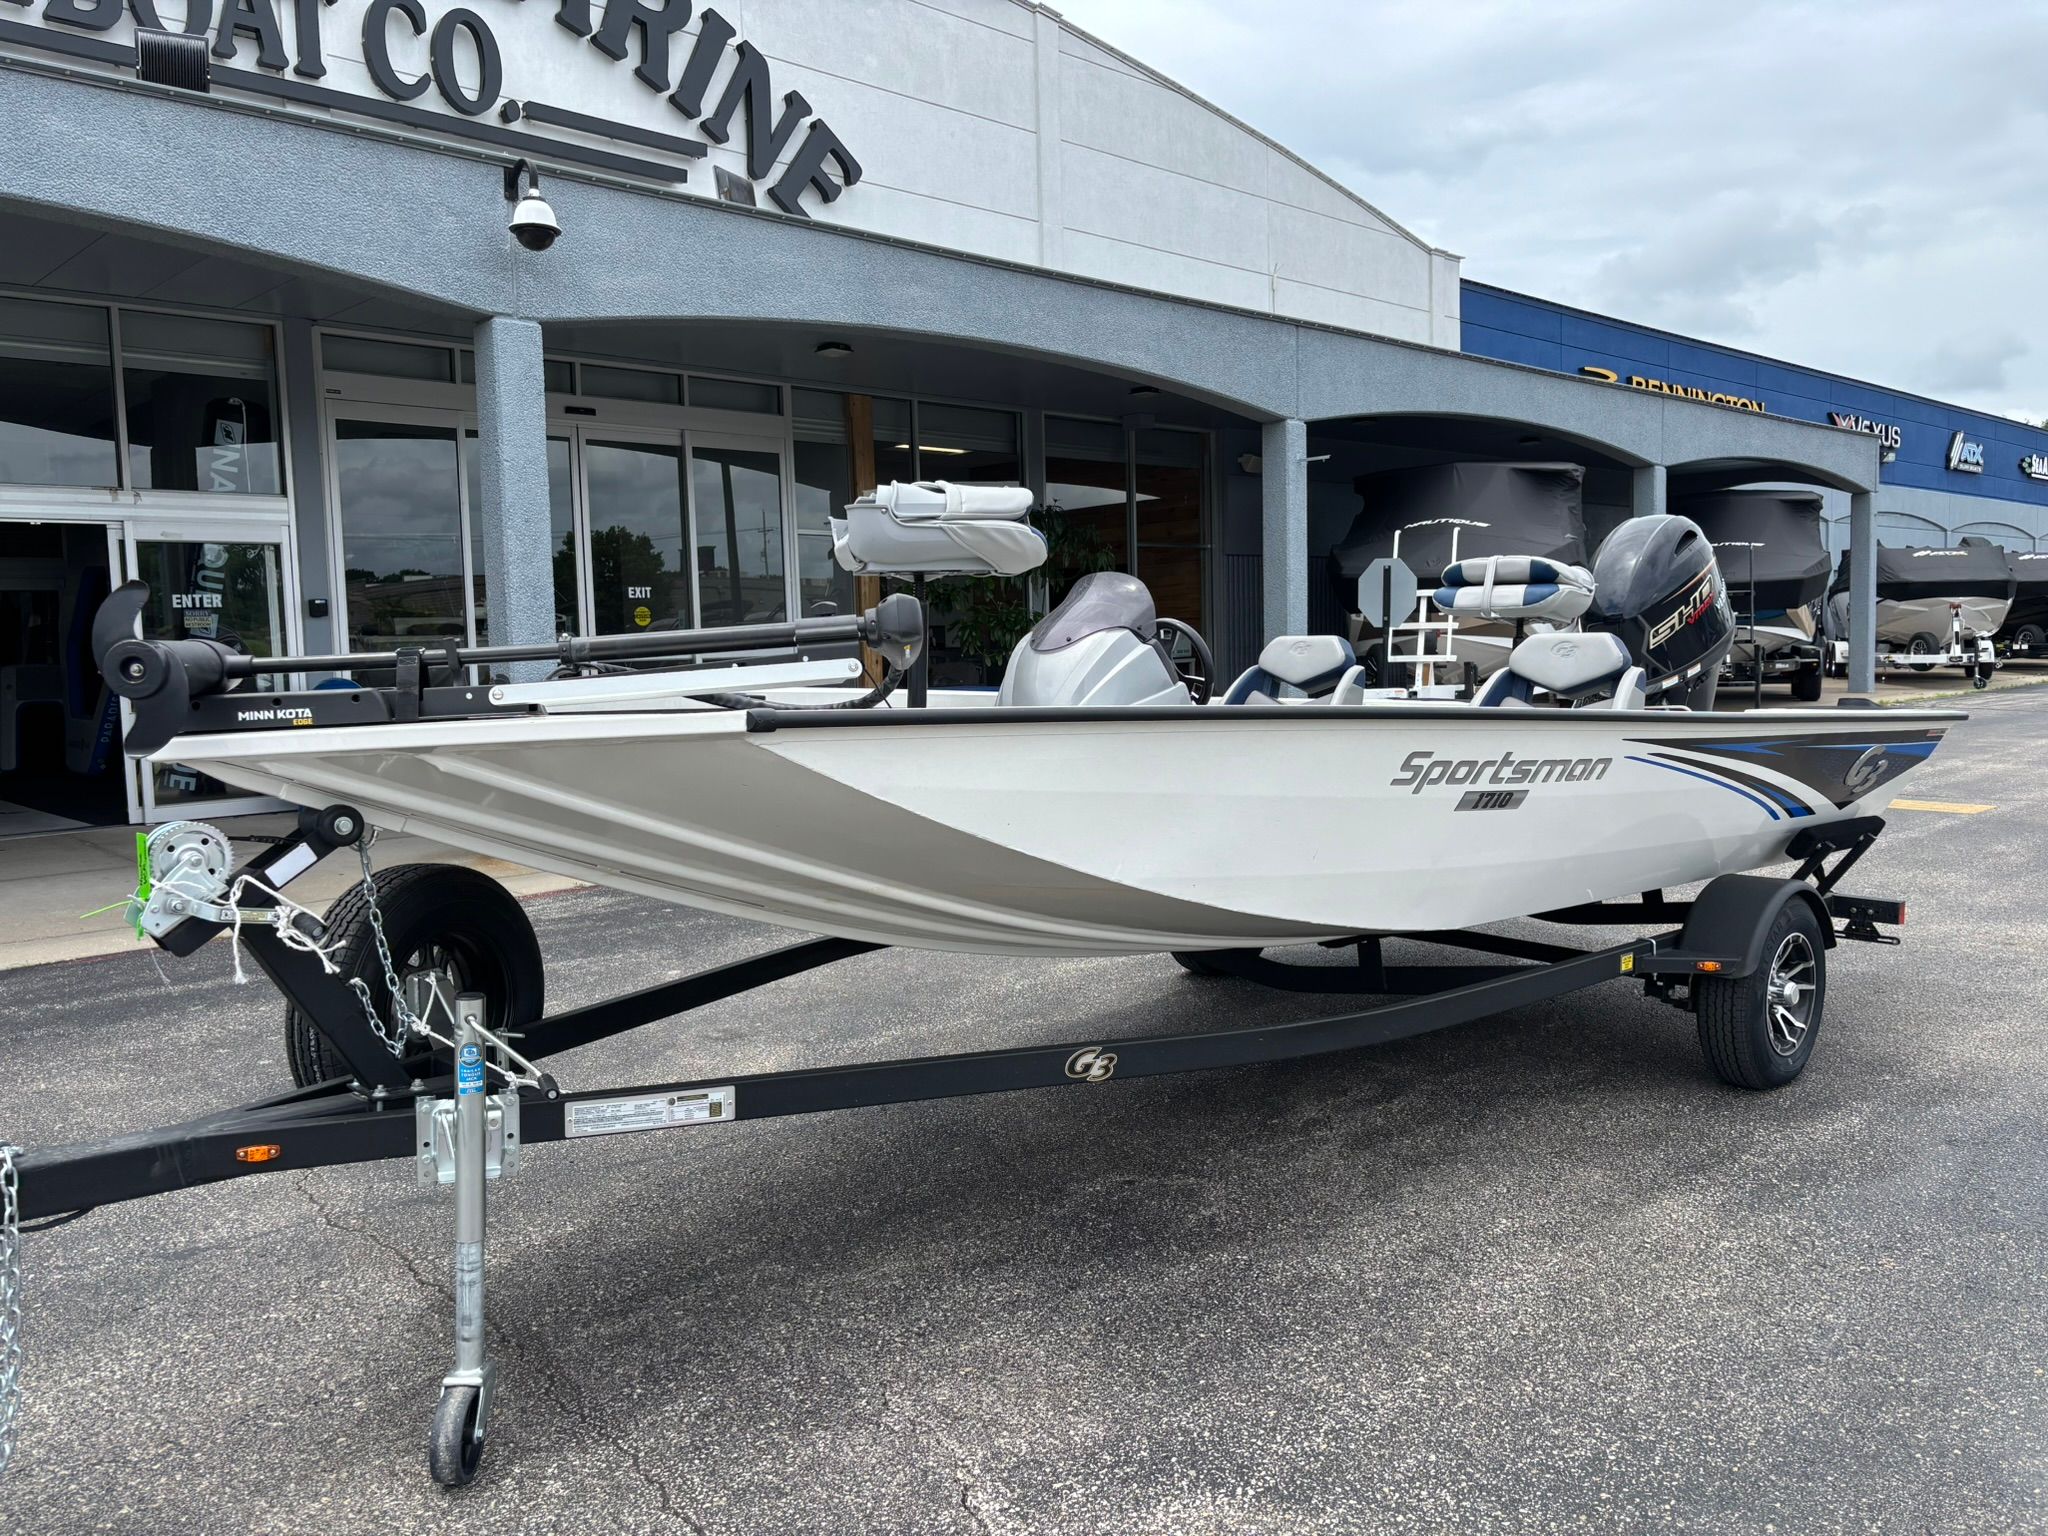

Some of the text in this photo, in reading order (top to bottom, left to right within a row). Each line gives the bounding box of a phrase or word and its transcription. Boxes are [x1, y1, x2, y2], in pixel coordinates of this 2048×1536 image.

[628, 586, 652, 599] EXIT
[171, 593, 223, 609] ENTER
[238, 707, 313, 721] MINN KOTA
[292, 717, 313, 726] EDGE
[1390, 751, 1613, 795] Sportsman
[1471, 792, 1514, 809] 1710
[1065, 1046, 1118, 1082] G3
